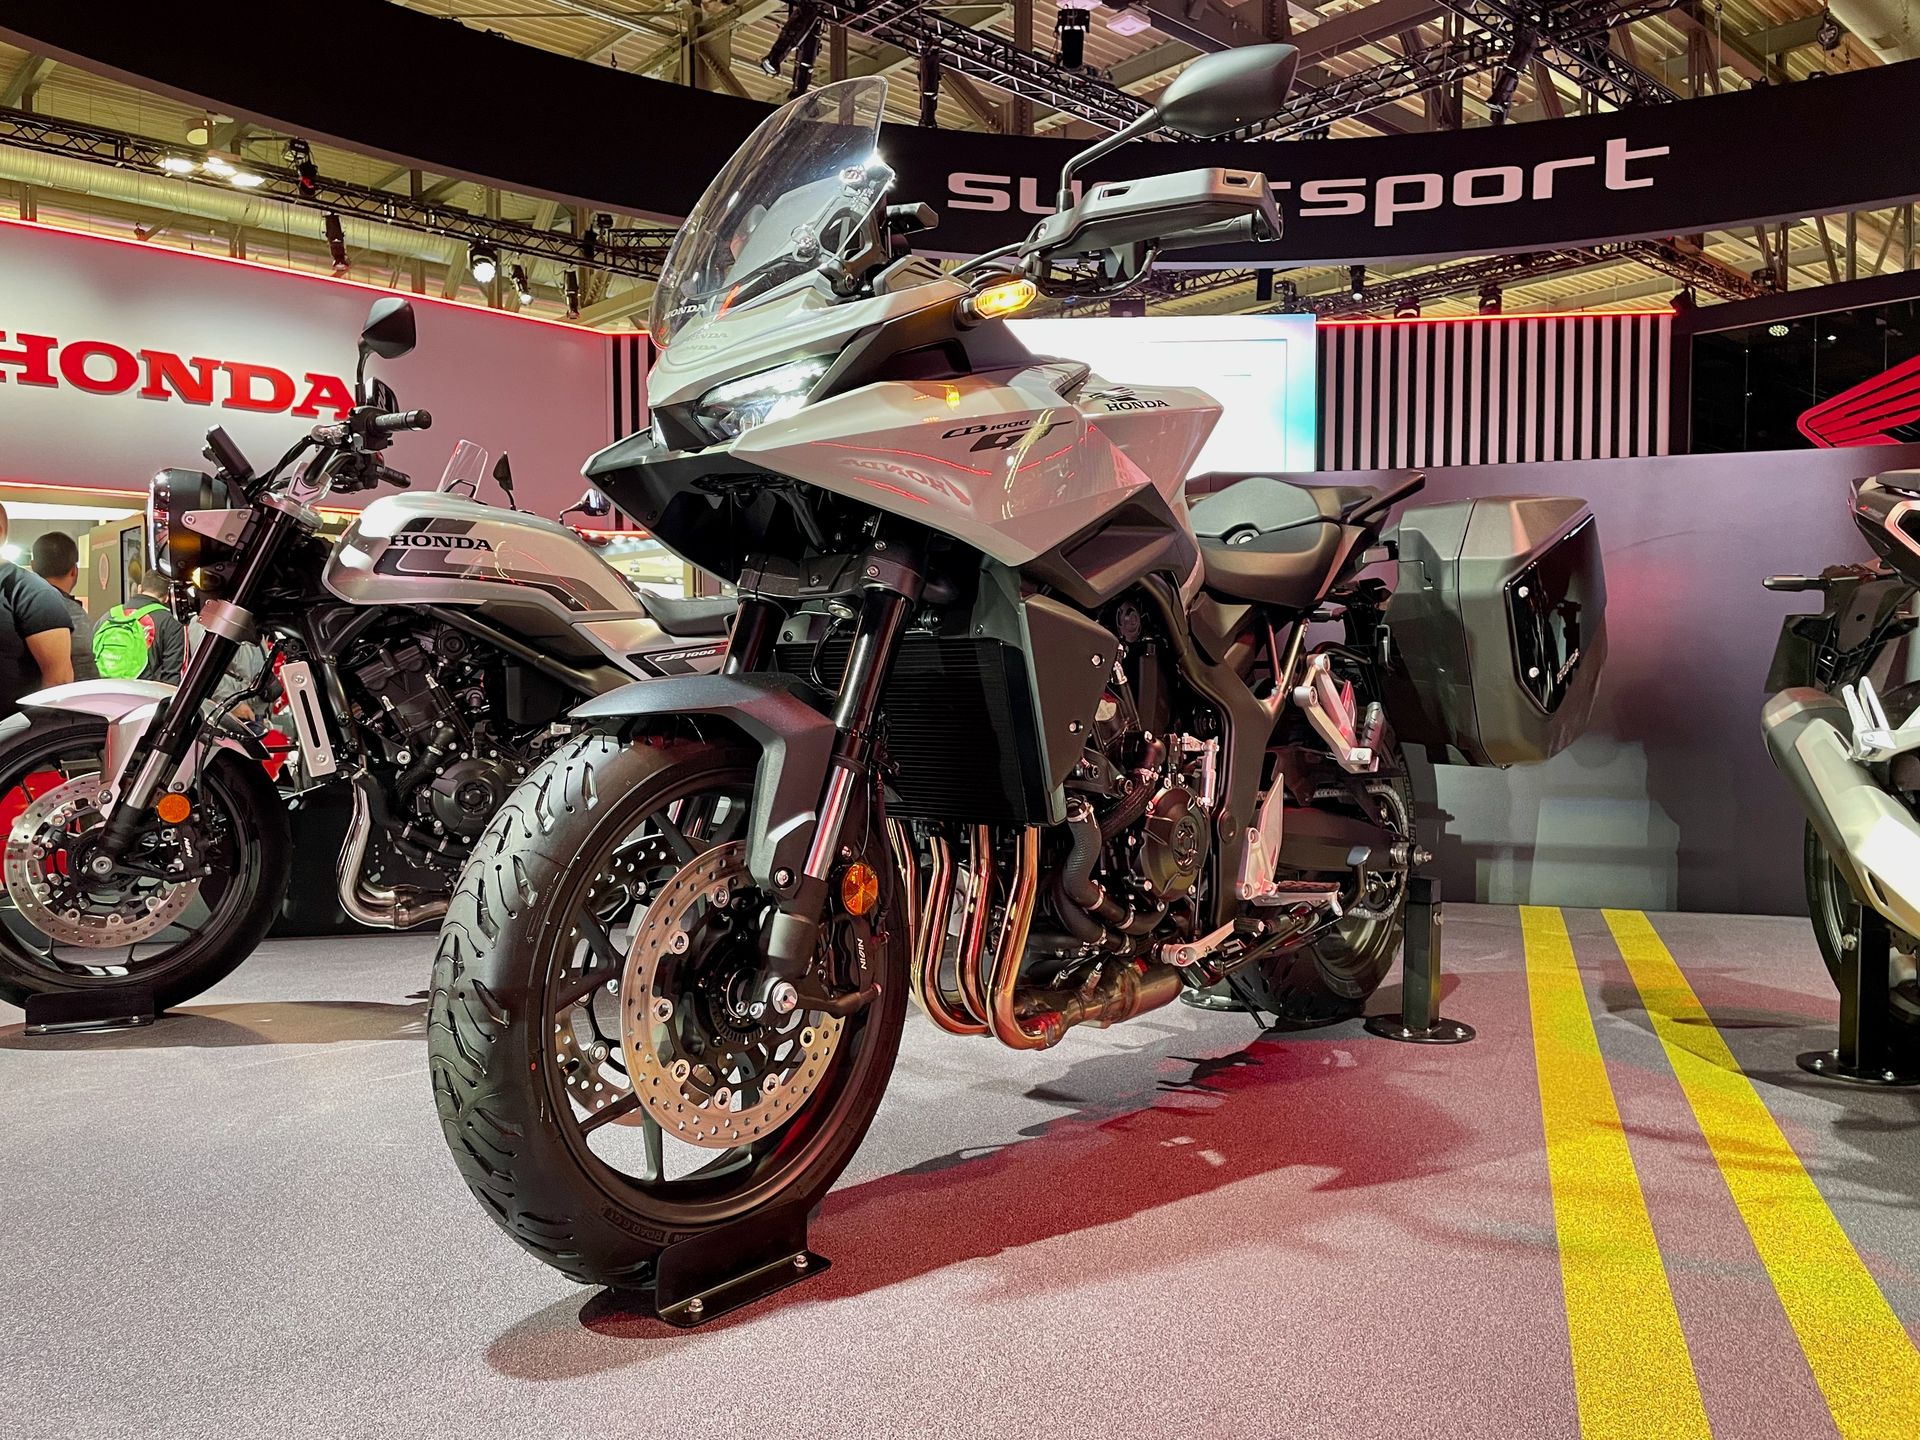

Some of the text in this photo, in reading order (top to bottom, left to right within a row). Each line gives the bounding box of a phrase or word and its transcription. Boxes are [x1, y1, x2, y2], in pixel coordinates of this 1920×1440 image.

[947, 137, 1671, 228] susport
[663, 303, 707, 321] HONDA
[0, 331, 357, 422] HONDA
[1104, 399, 1171, 412] HONDA
[388, 534, 495, 553] HONDA
